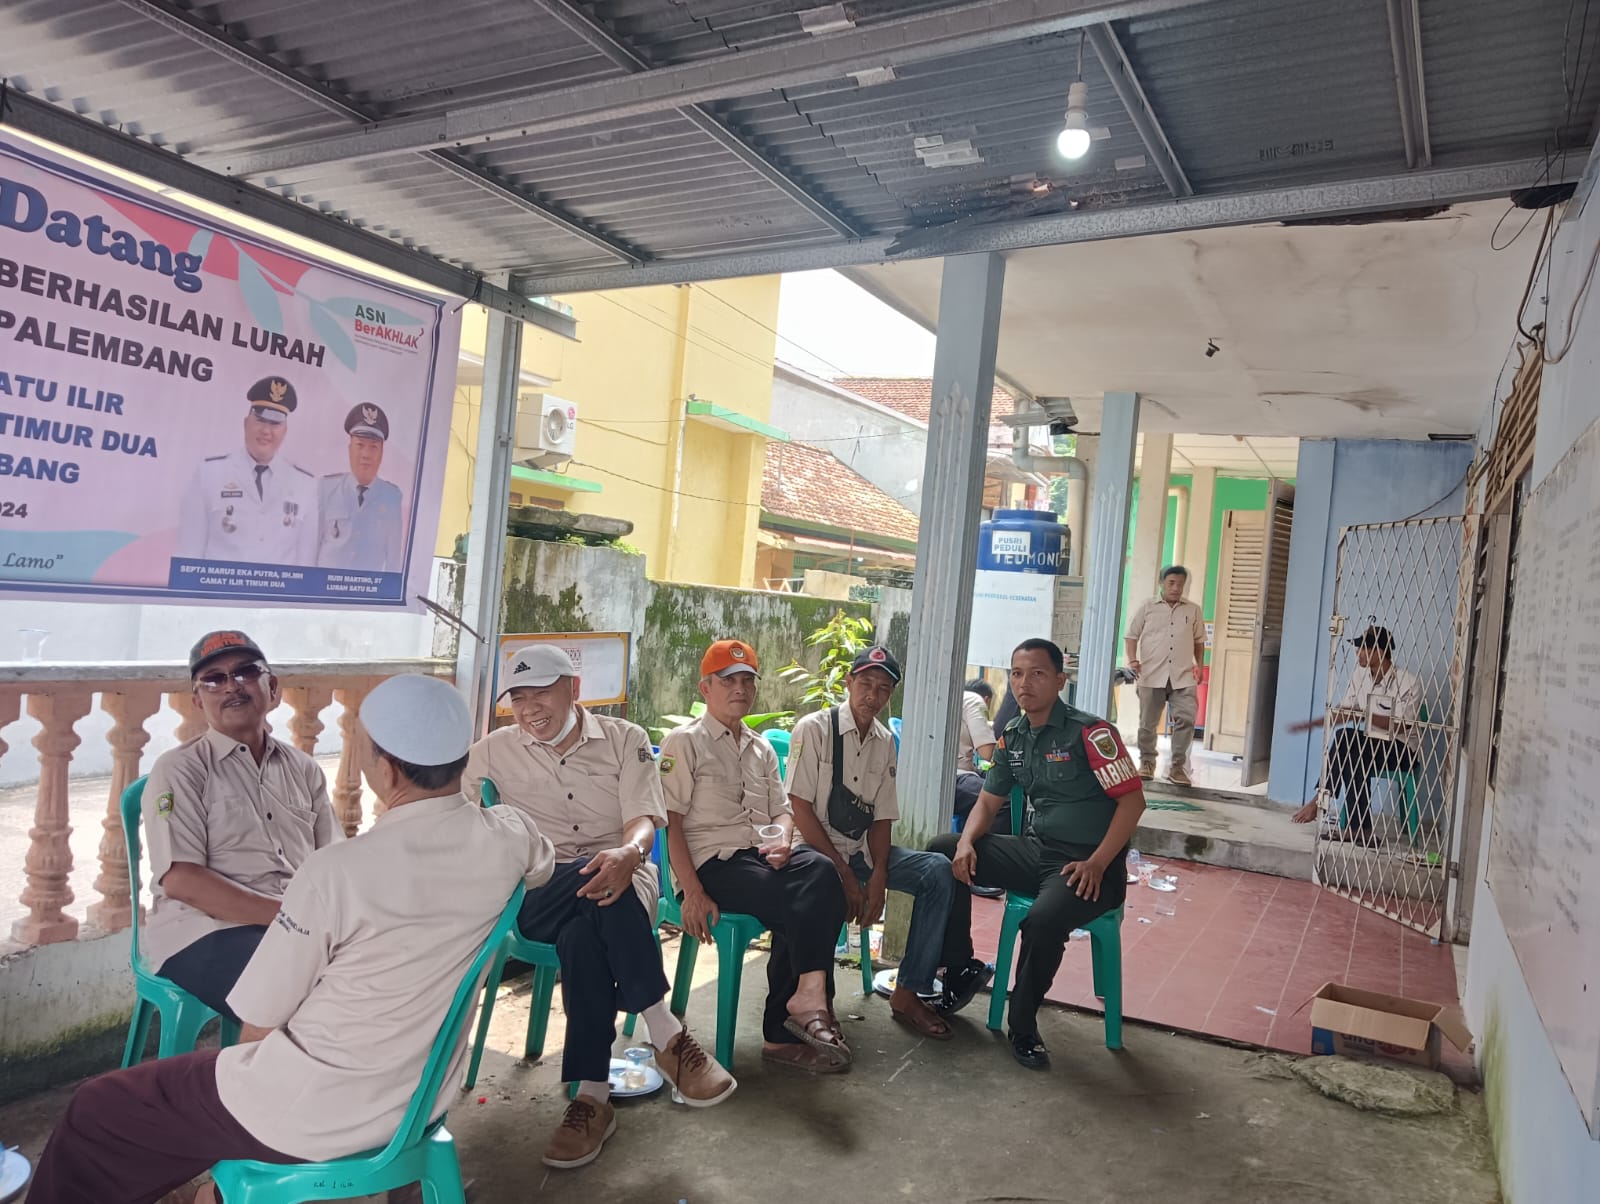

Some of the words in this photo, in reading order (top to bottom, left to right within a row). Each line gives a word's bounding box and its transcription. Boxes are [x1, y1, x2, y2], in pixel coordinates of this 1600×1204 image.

[0, 177, 202, 293] Datang
[355, 305, 386, 325] ASN
[0, 310, 213, 382] PALEMBANG
[232, 322, 325, 367] LURAH
[354, 319, 424, 349] BerAKHLAK
[67, 385, 124, 415] ILIR
[0, 412, 93, 448] TIMUR
[101, 430, 157, 458] DUA
[0, 501, 28, 518] 24
[994, 544, 1027, 553] PEDULI
[180, 565, 206, 573] SEPTA
[199, 577, 227, 585] CAMAT
